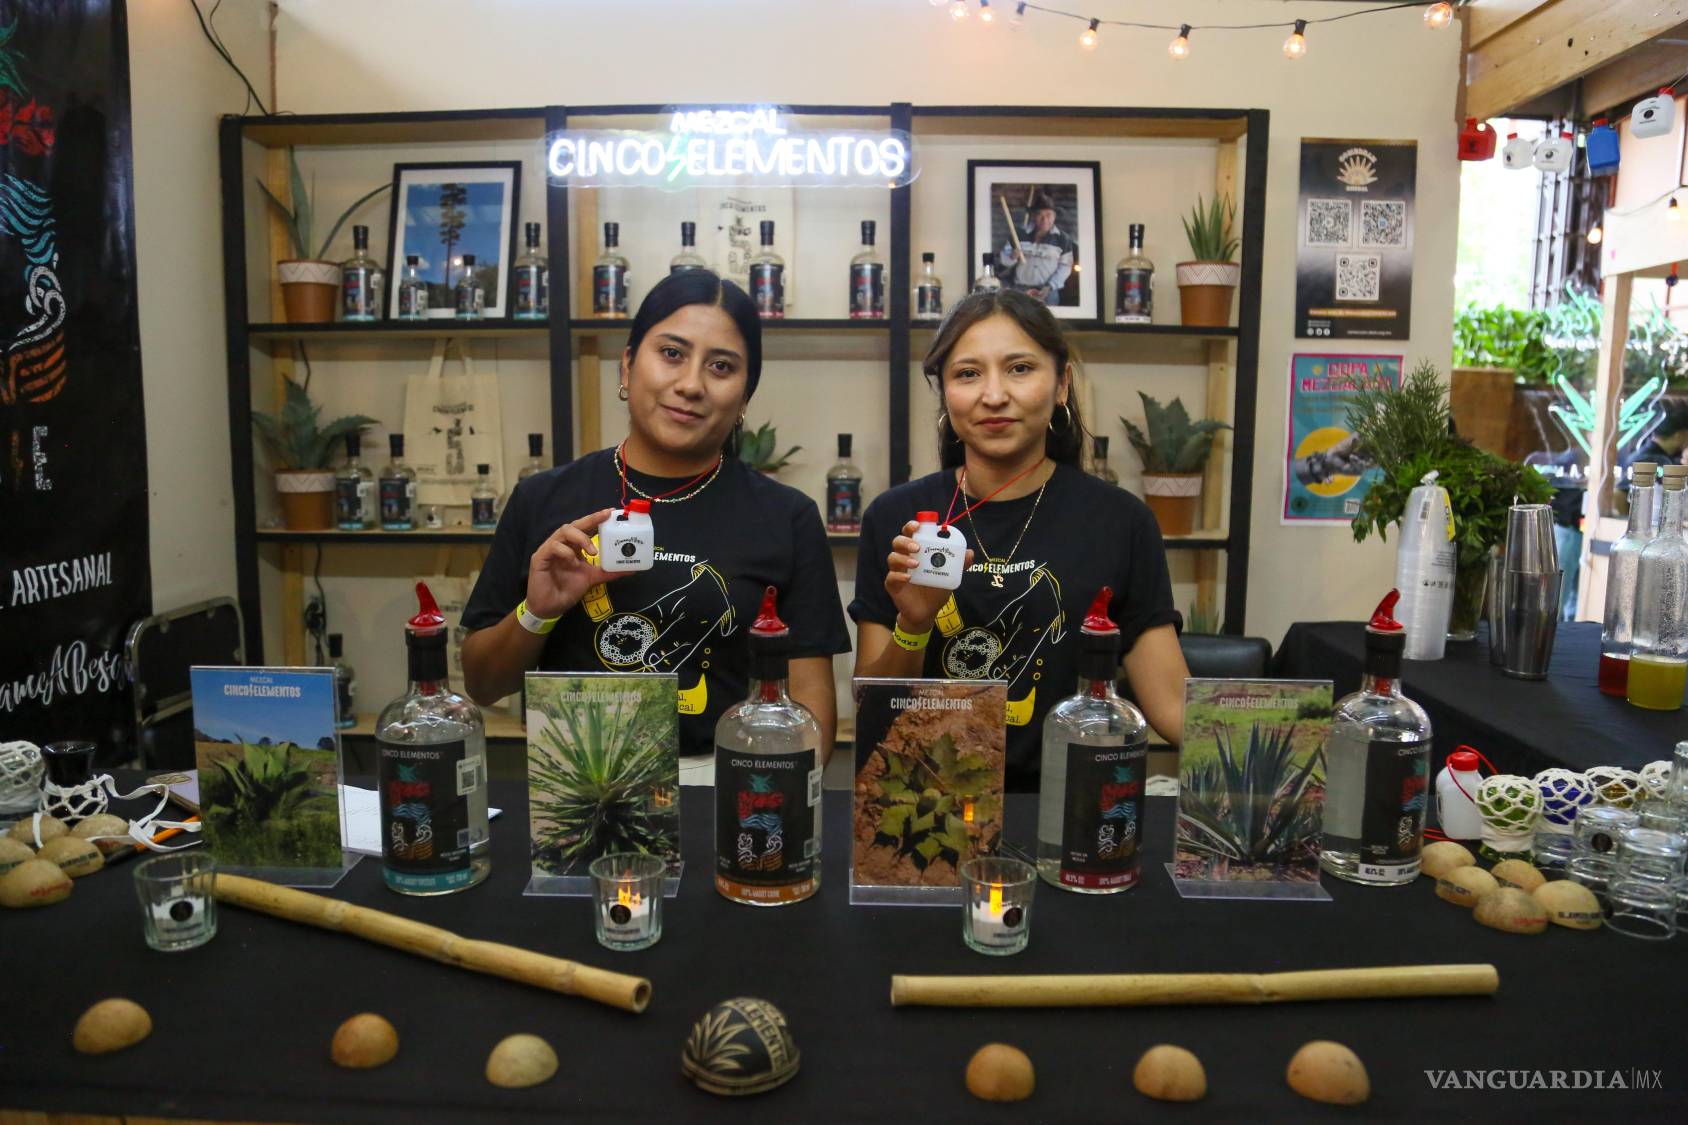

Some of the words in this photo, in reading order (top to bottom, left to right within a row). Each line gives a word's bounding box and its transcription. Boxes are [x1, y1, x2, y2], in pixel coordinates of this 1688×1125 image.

[669, 109, 787, 134] MEZCAL
[549, 138, 665, 176] CINCO
[686, 136, 905, 178] ELEMENTOS
[652, 552, 696, 563] EMENTOS
[988, 560, 1035, 574] ELEMENTOS
[11, 552, 113, 607] ARTESANAL
[224, 684, 249, 697] CINCO
[254, 685, 301, 698] ELEMENTOS
[890, 697, 917, 710] CINCO
[922, 698, 973, 710] ELEMENTOS
[1220, 697, 1247, 709] CINCO
[400, 750, 441, 760] ELEMENTOS
[1095, 753, 1118, 762] CINCO
[731, 759, 753, 768] CINCO
[754, 760, 795, 769] ELEMENTOS
